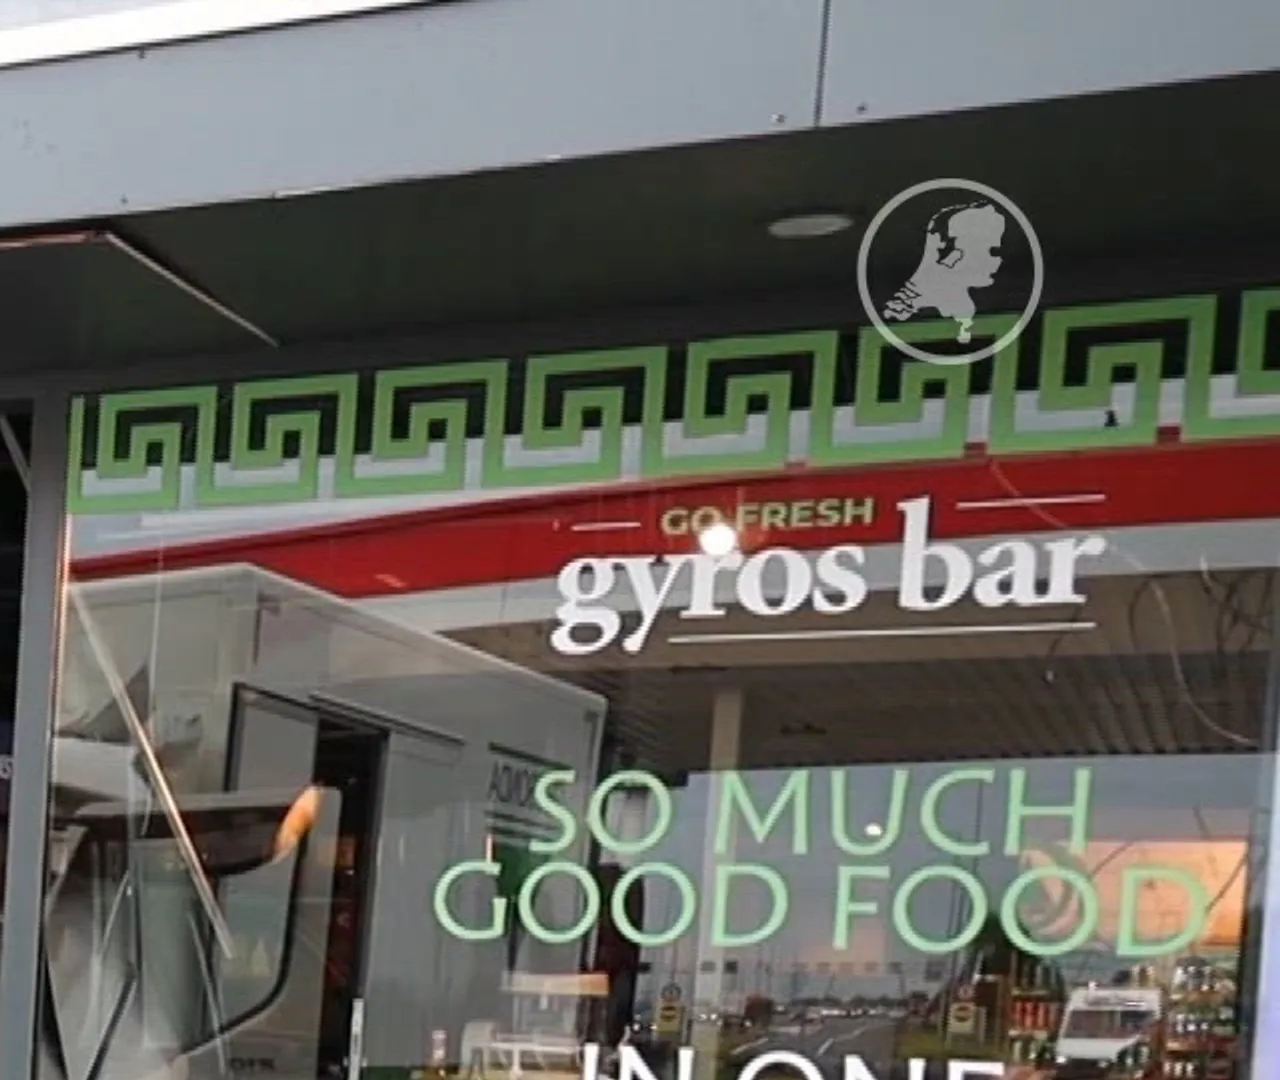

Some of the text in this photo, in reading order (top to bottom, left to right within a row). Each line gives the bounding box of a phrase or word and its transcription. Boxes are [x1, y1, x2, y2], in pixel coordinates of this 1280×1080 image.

[660, 498, 874, 536] GO FRESH
[550, 496, 1106, 655] gyros bar
[529, 769, 671, 854] SO
[714, 768, 1092, 856] MUCH
[433, 860, 1209, 956] GOOD FOOD
